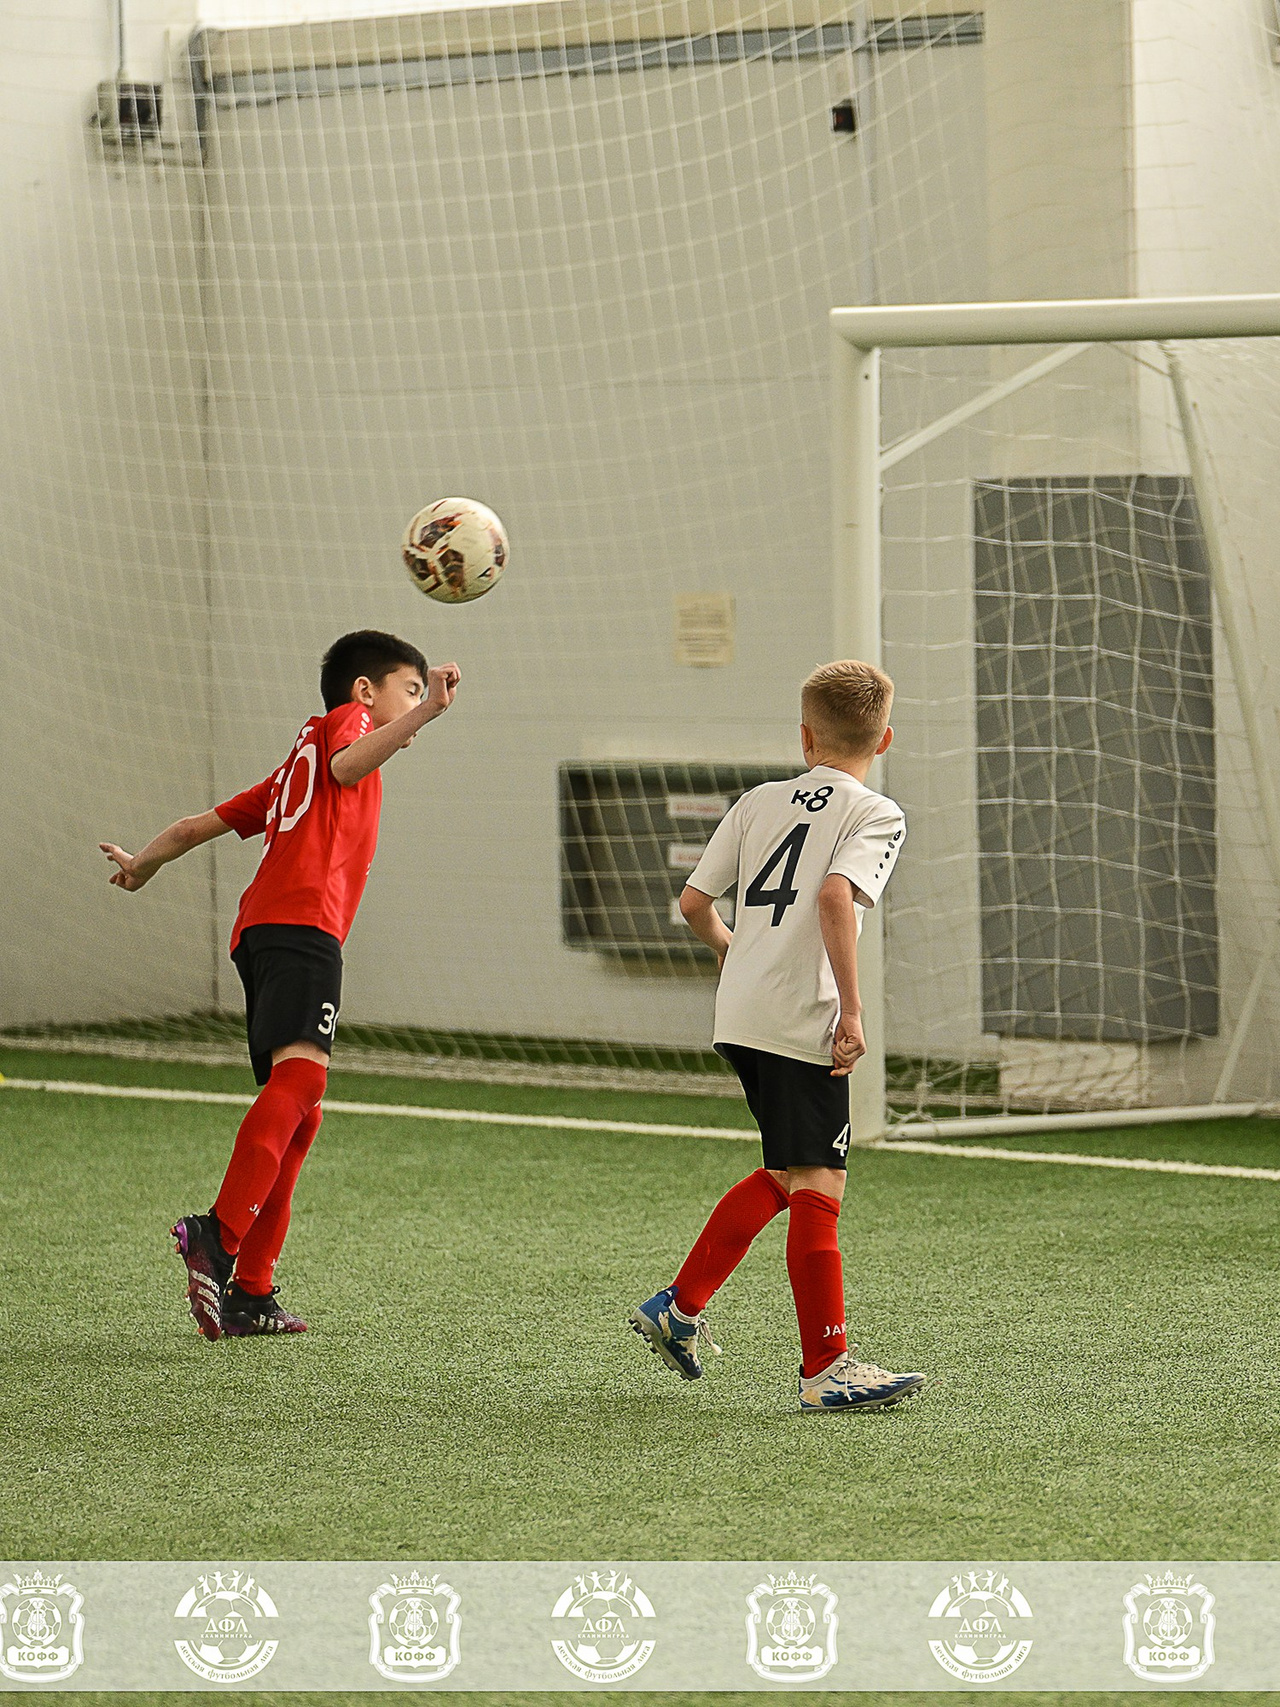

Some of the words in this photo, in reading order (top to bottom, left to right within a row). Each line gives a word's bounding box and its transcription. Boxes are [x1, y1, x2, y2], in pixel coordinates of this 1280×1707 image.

[744, 822, 811, 927] 4
[832, 1122, 850, 1157] 4
[823, 1322, 847, 1338] JAK
